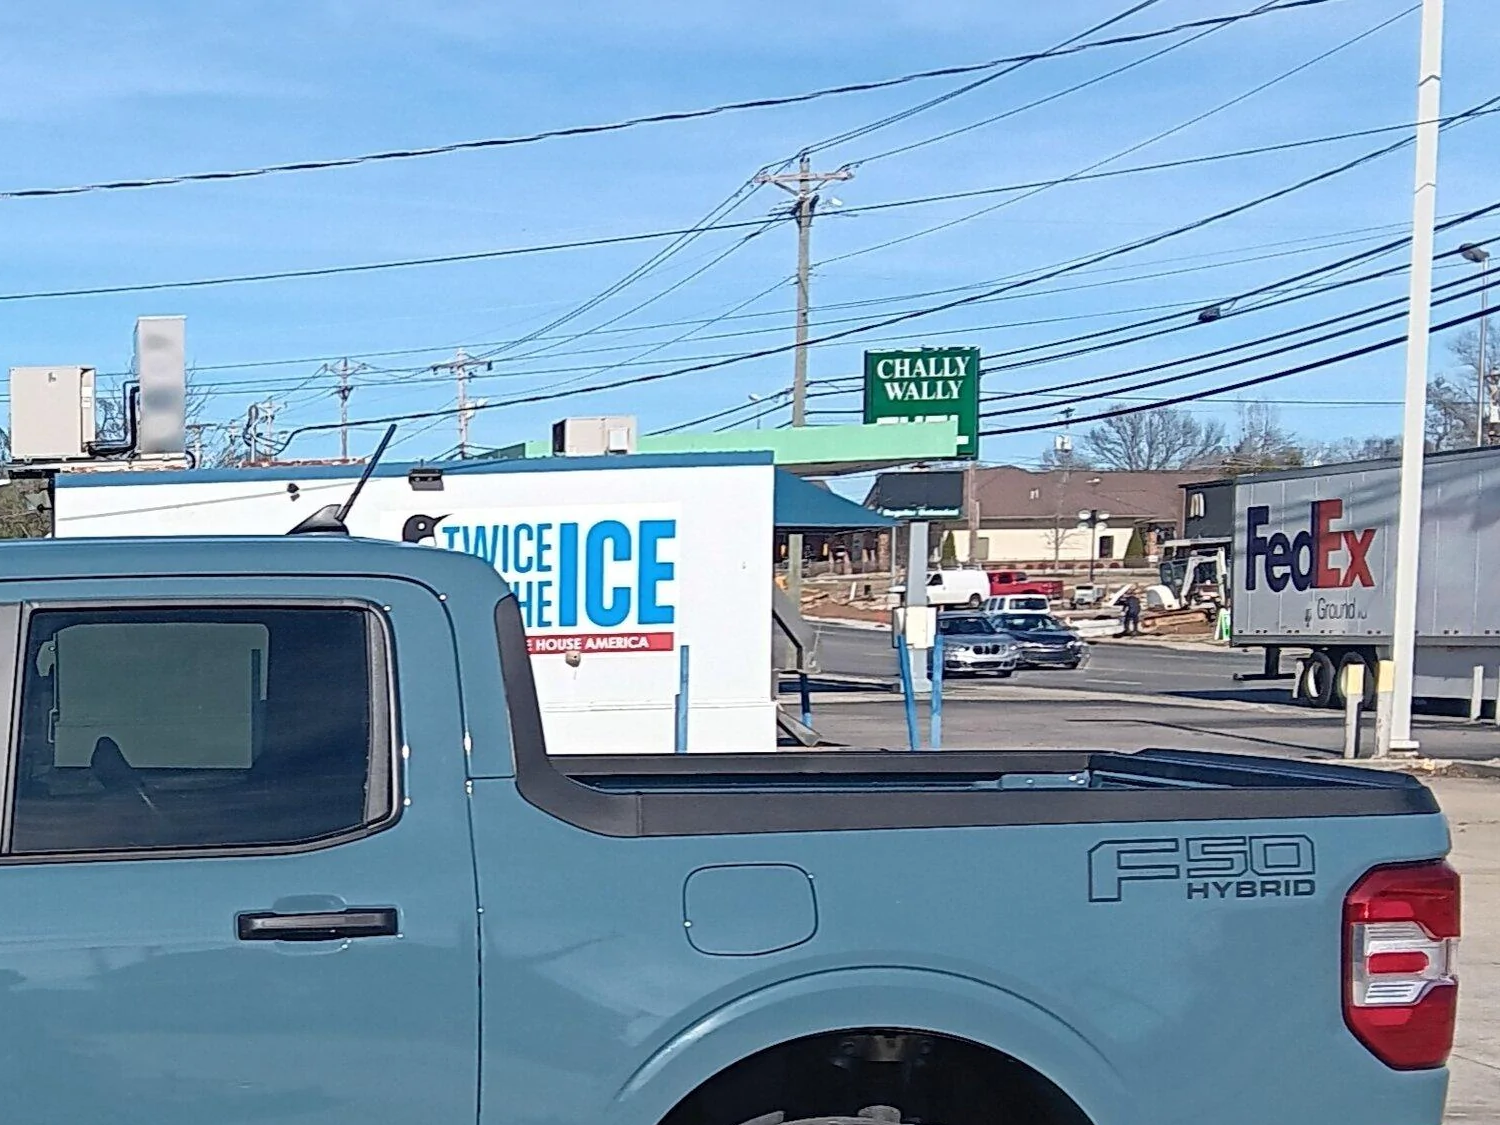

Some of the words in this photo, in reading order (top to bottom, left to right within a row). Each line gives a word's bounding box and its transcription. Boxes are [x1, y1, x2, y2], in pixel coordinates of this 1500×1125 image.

[876, 356, 971, 380] CHALLY
[884, 380, 964, 401] WALLY
[1245, 498, 1378, 593] FedEx
[558, 520, 676, 628] ICE
[508, 580, 553, 628] HE
[1316, 597, 1356, 620] Ground
[535, 637, 582, 651] HOUSE
[586, 636, 650, 650] AMERICA
[1186, 878, 1317, 900] HYBRID
